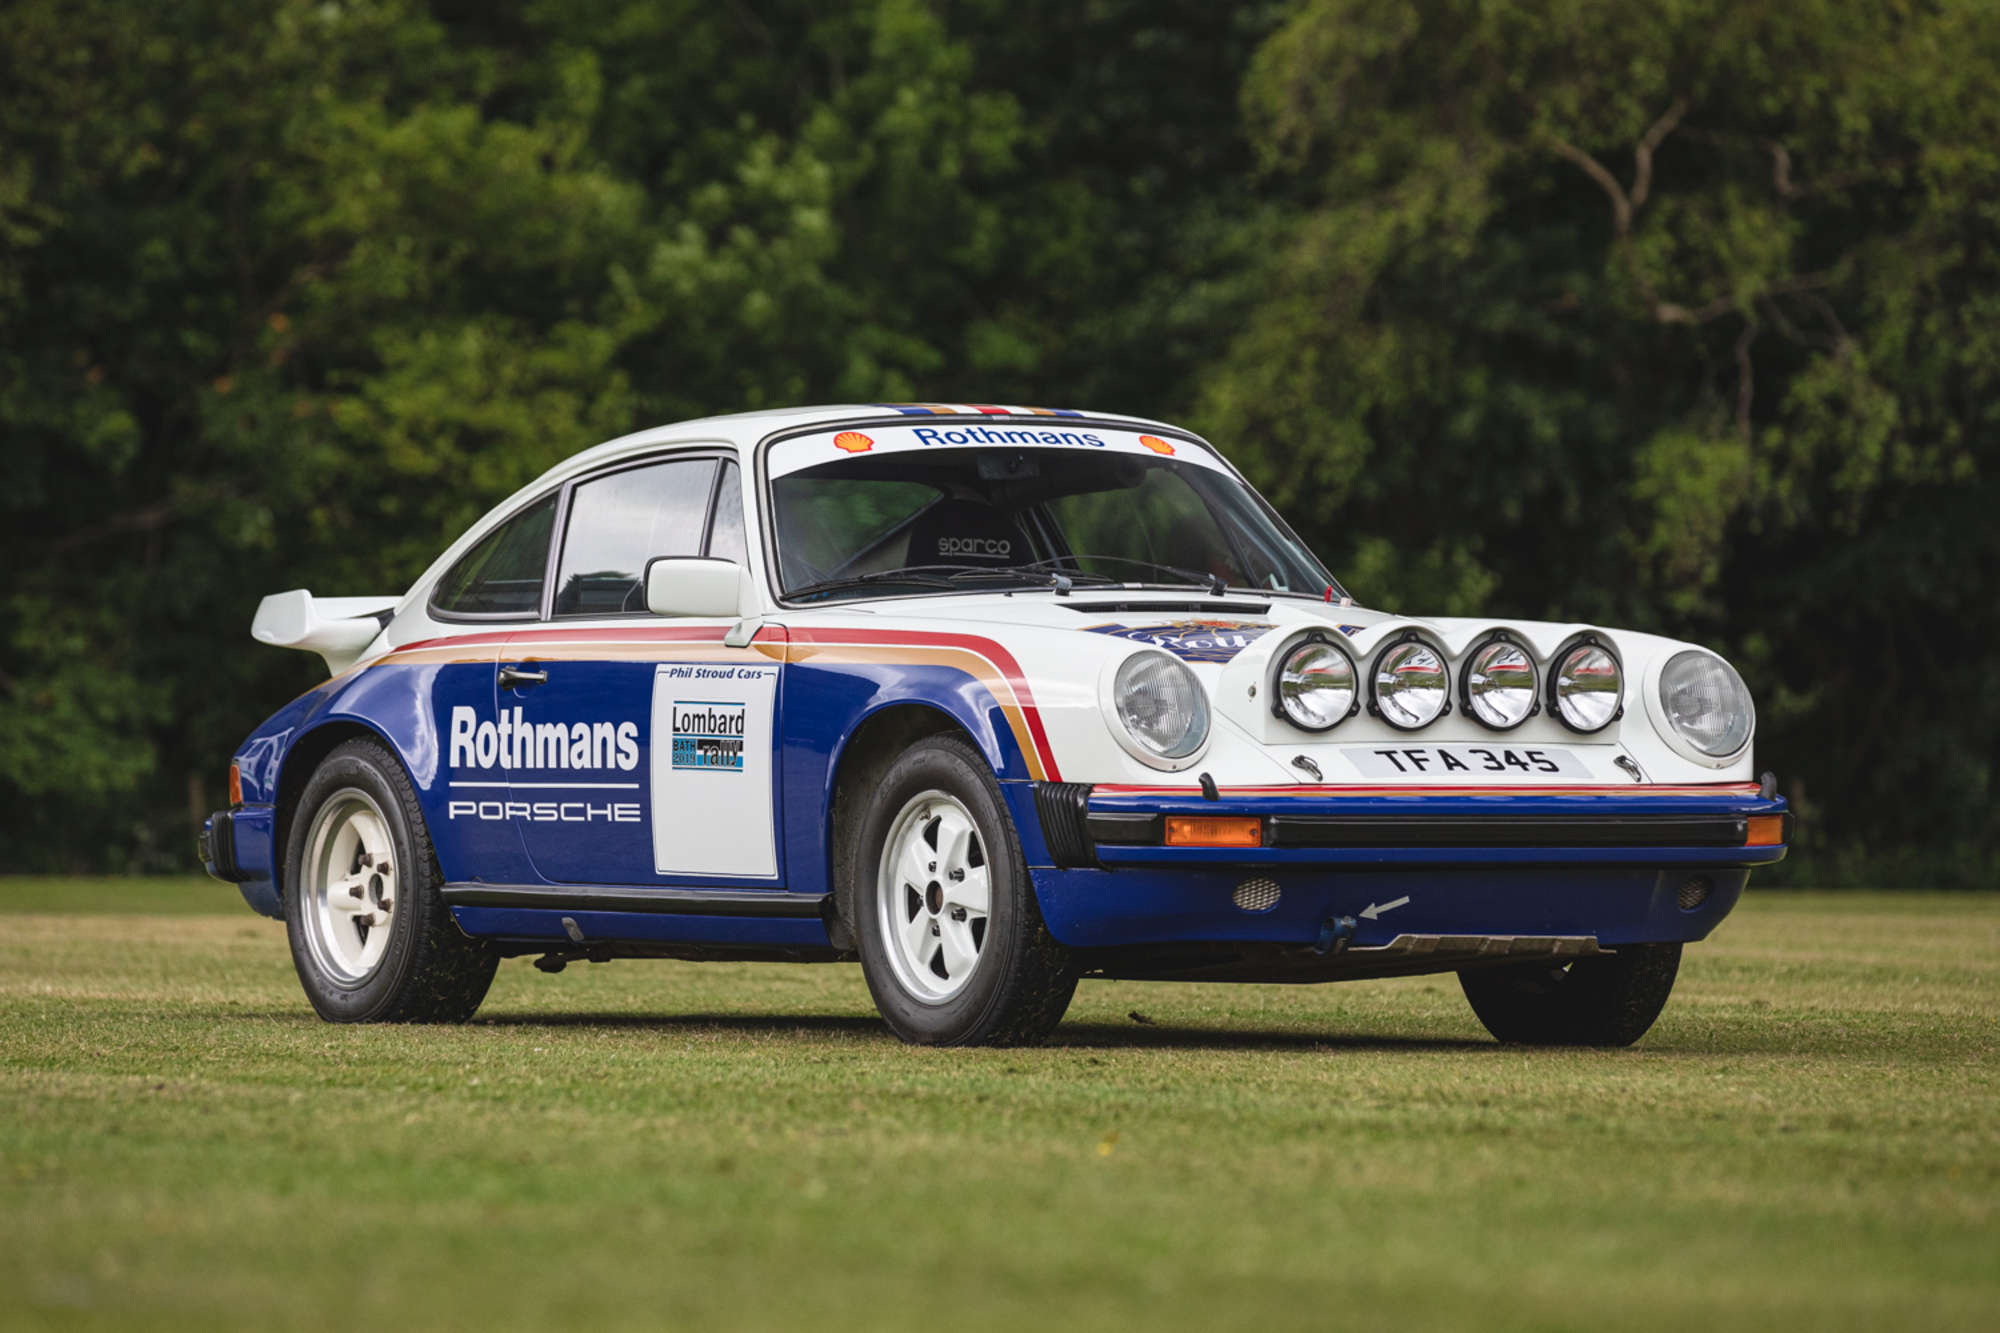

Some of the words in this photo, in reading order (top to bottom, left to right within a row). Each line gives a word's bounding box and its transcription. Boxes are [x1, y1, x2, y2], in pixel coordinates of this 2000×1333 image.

[913, 427, 1106, 448] Rothmans
[938, 537, 1011, 556] sparco
[669, 667, 693, 679] Phil
[695, 668, 735, 679] Stroud
[737, 669, 762, 680] Cars
[672, 706, 744, 734] Lombard
[450, 706, 639, 770] Rothmans
[673, 740, 696, 752] BATH
[1374, 749, 1470, 773] TFA
[1468, 749, 1560, 773] 345
[449, 801, 641, 822] PORSCHE
